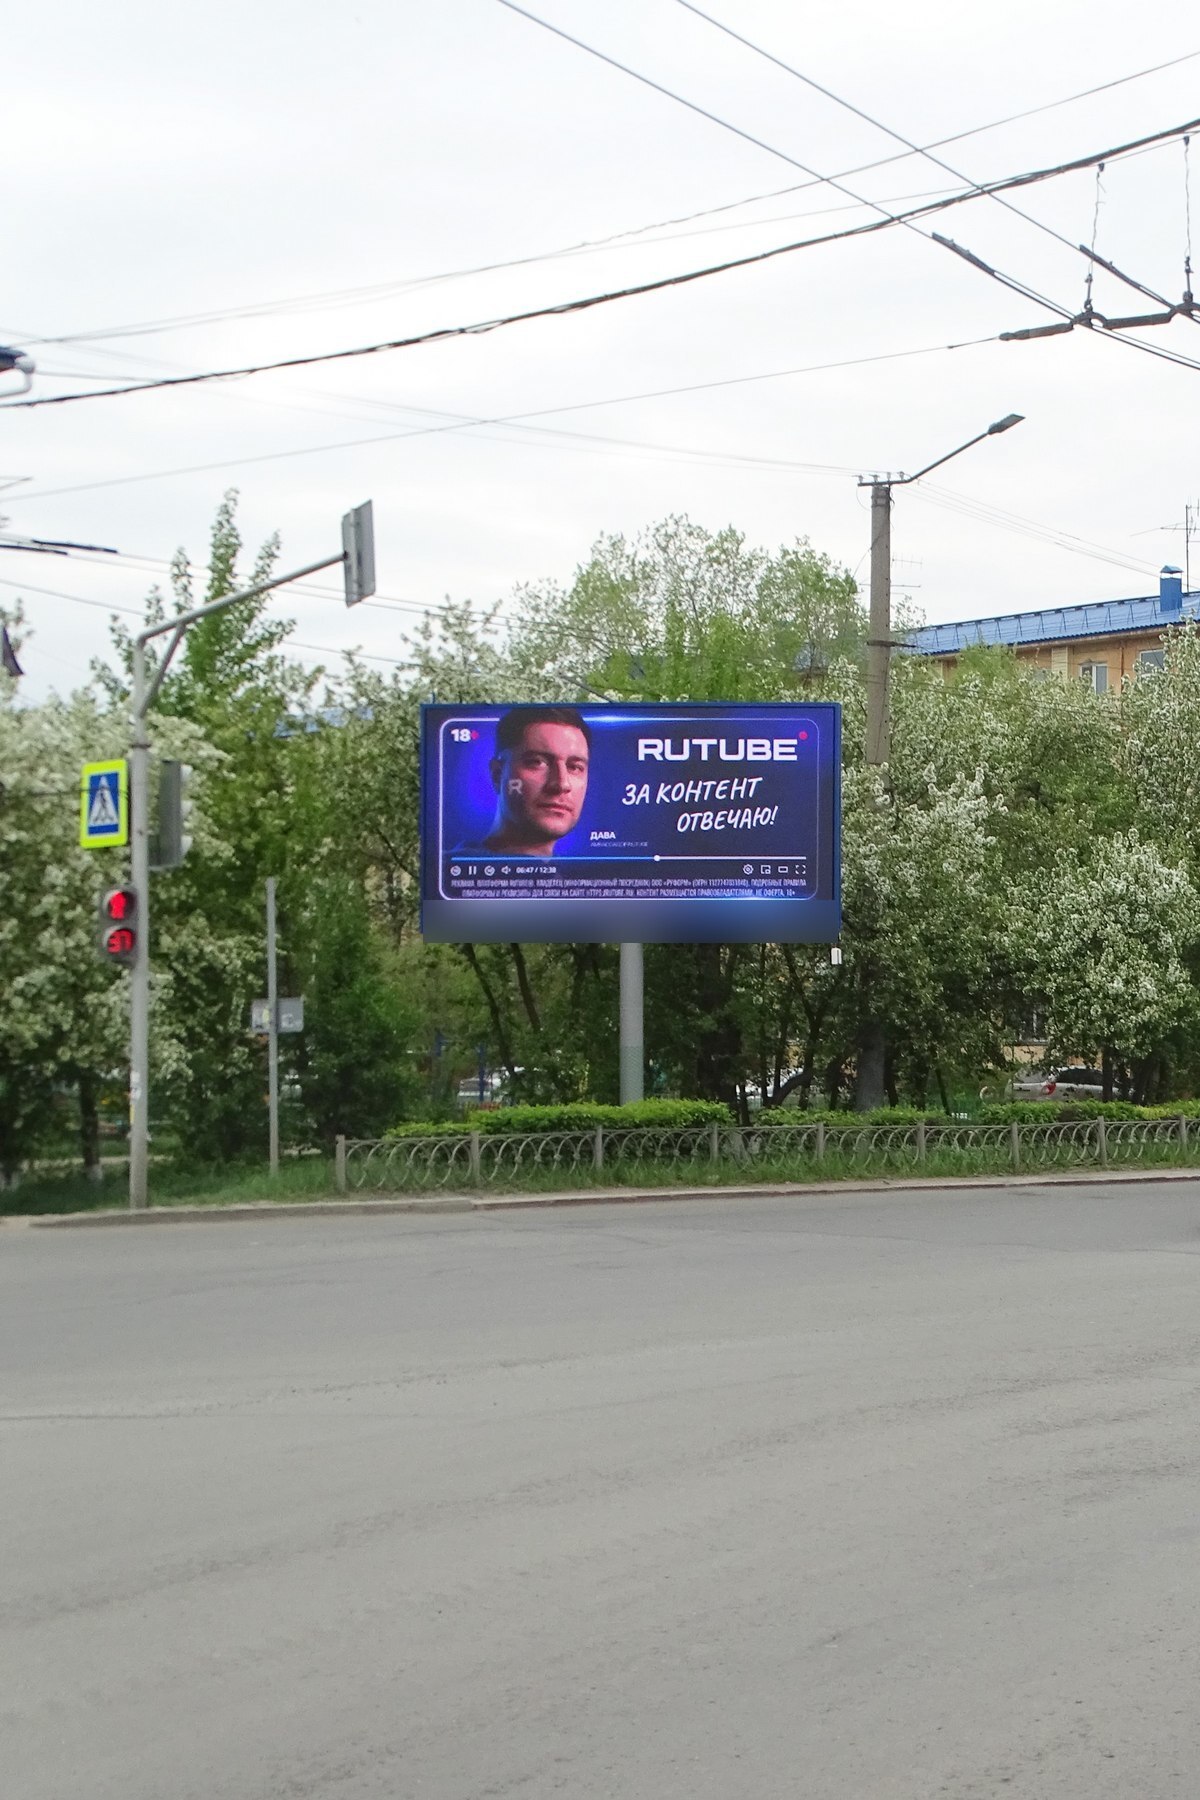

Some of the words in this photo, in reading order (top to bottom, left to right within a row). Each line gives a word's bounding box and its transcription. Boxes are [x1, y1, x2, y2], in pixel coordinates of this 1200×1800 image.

[638, 738, 798, 761] RUTUBE
[621, 783, 650, 806] ЗА
[655, 776, 763, 804] КОНТЕНТ
[677, 805, 779, 833] ОТВЕЧАЮ!
[590, 831, 617, 841] ДАВА
